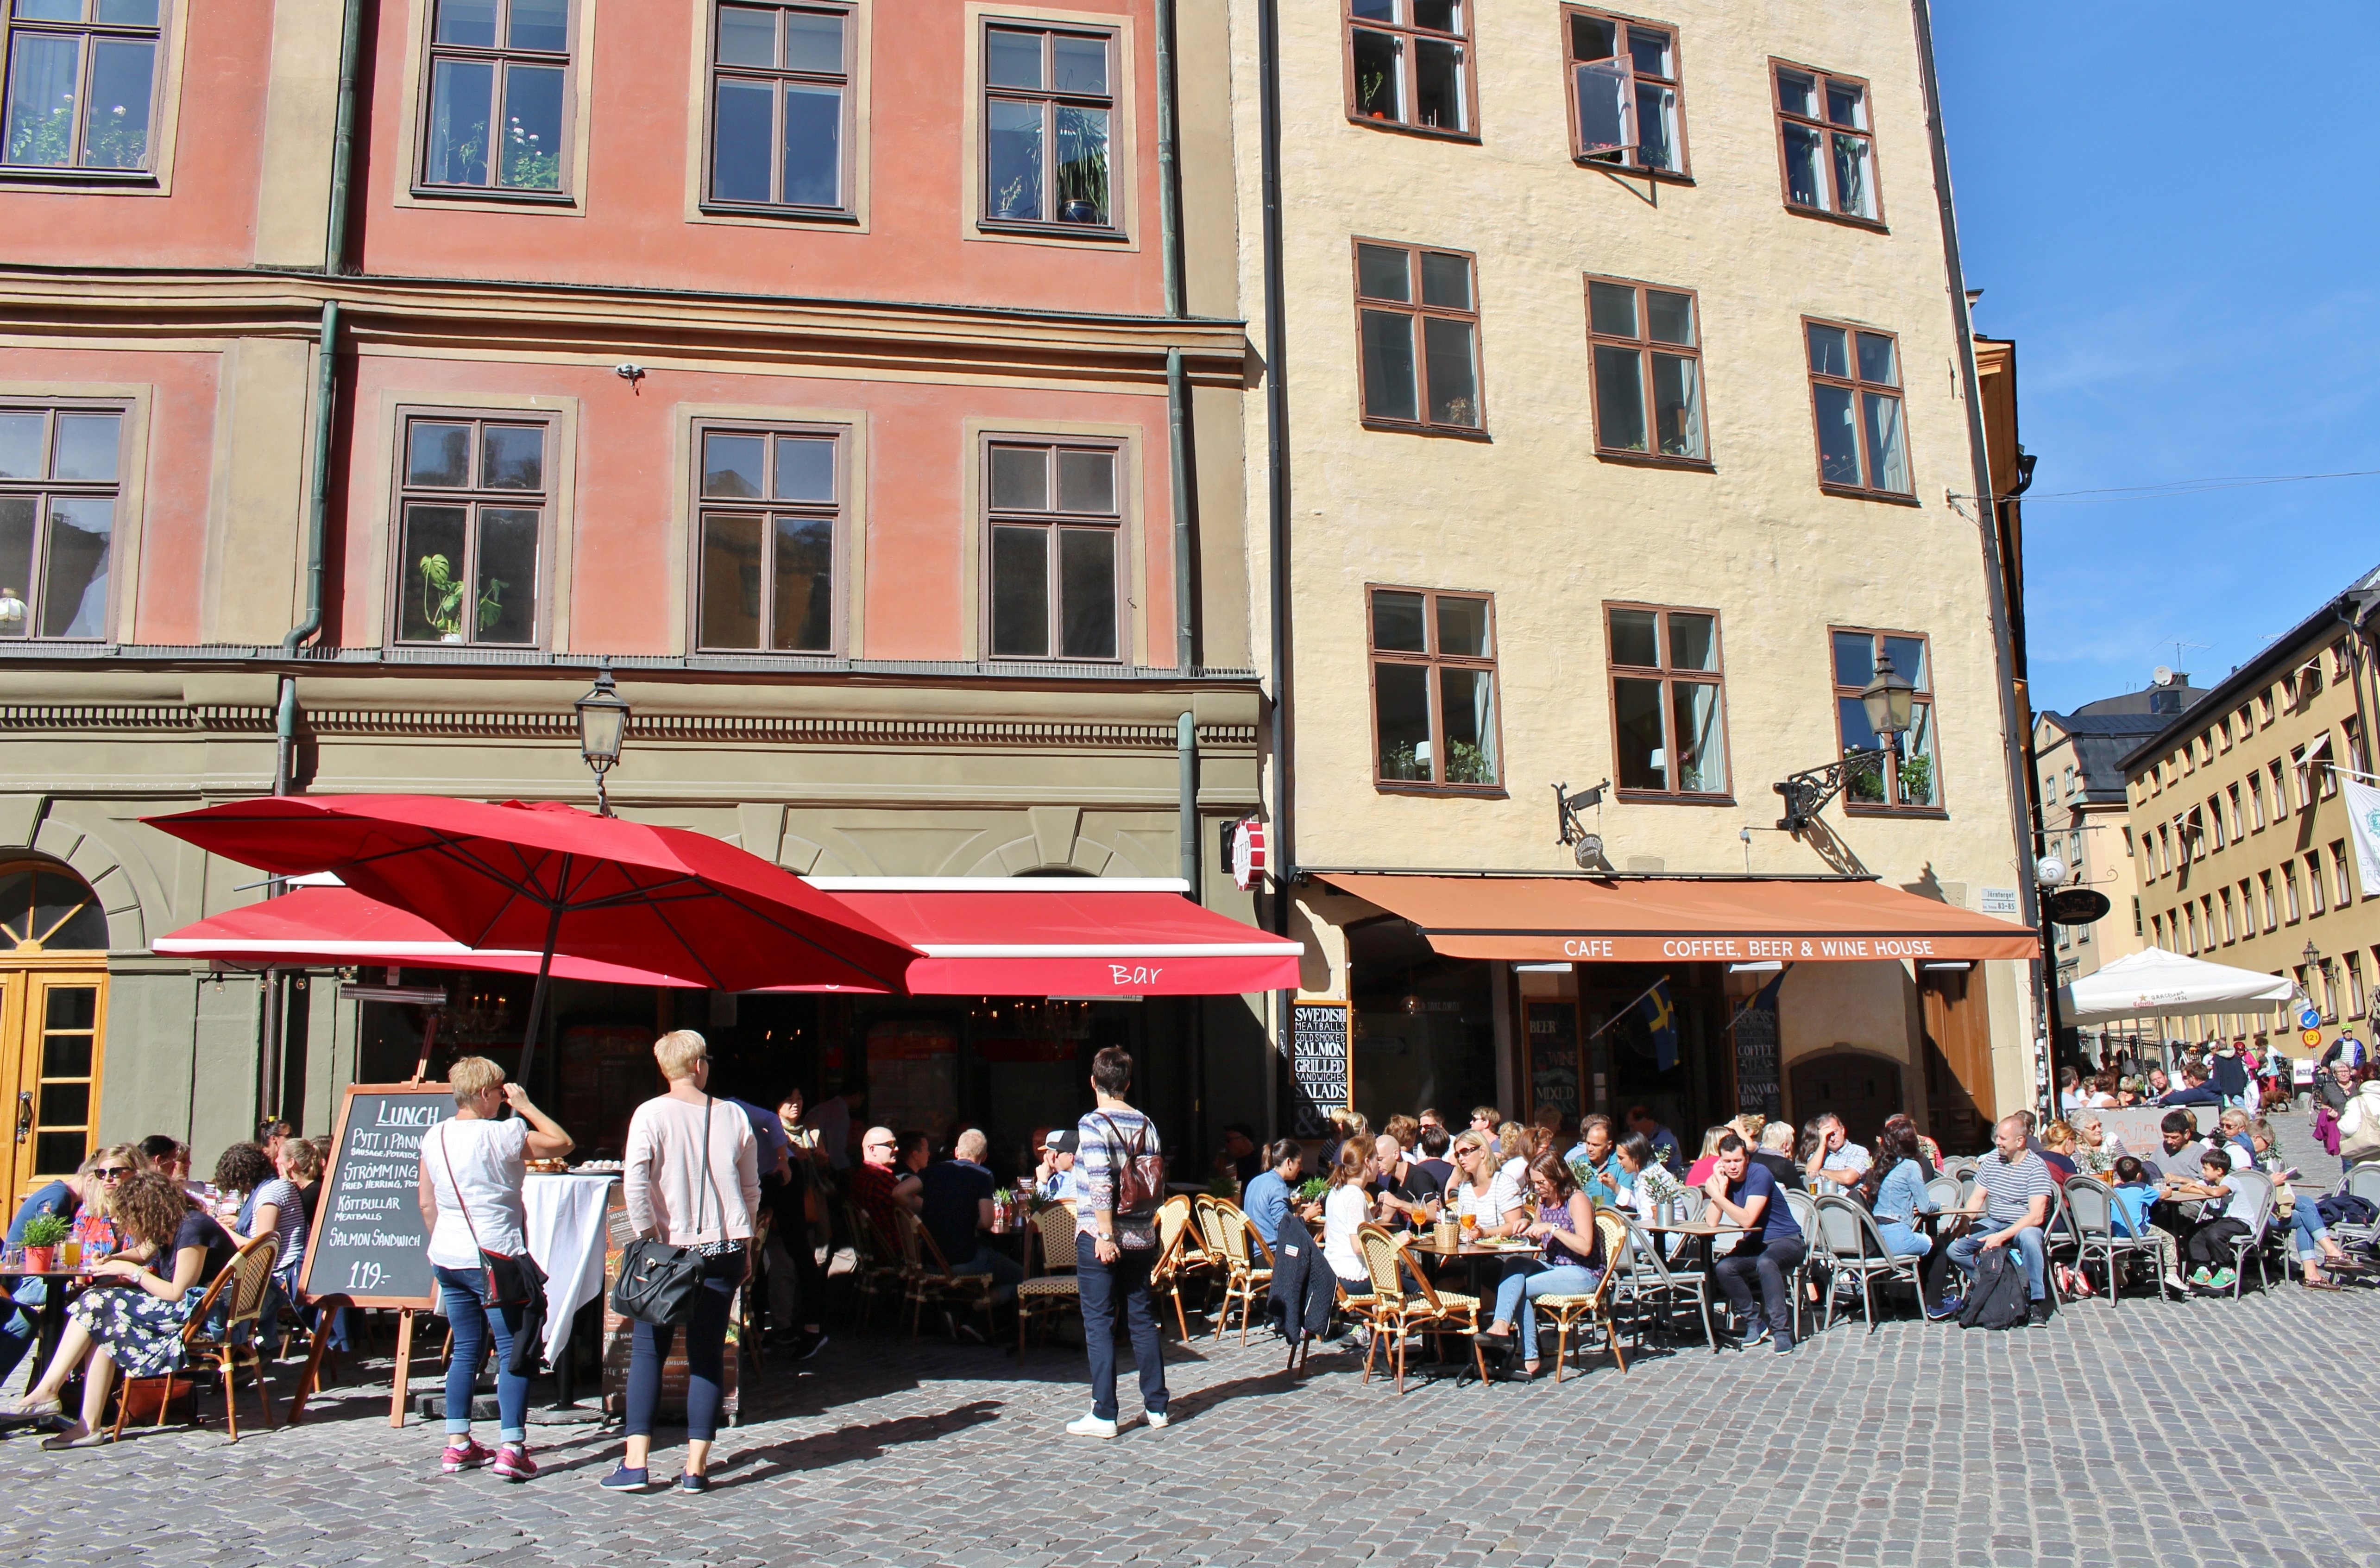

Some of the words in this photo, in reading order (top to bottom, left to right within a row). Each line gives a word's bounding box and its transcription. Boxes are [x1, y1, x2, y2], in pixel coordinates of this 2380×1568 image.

[1235, 840, 1249, 866] JTP
[1987, 891, 2014, 899] Järntorget
[1564, 940, 1613, 957] CAFE
[1663, 940, 1741, 958] COFFEE,
[1749, 941, 1793, 956] BEER
[1801, 941, 1813, 956] &
[1820, 941, 1868, 956] WINE
[1875, 940, 1934, 955] HOUSE
[1108, 964, 1163, 985] Bar
[2151, 991, 2184, 1000] BARCELONA
[1295, 1008, 1347, 1022] SWEDISH
[1295, 1022, 1345, 1031] MEATBALLS
[1529, 1020, 1556, 1033] BEER
[1295, 1033, 1314, 1042] COLD
[1316, 1033, 1345, 1043] SMOKED
[1295, 1042, 1345, 1056] SALMON
[1738, 1045, 1774, 1056] COFFEE
[1547, 1051, 1576, 1066] WINE
[1295, 1059, 1345, 1073] GRILLED
[1296, 1073, 1346, 1081] SANDWICHES
[1296, 1083, 1347, 1099] SALADS
[1536, 1087, 1574, 1100] MIXED
[1738, 1083, 1780, 1094] CINNAMON
[1741, 1094, 1763, 1106] BUNS
[377, 1100, 439, 1125] LUNCH
[1316, 1104, 1347, 1118] MO
[352, 1127, 382, 1149] PYTT
[390, 1132, 422, 1150] PANN
[344, 1162, 418, 1181] STRÖMMING
[341, 1181, 363, 1191] FRIED
[365, 1179, 403, 1189] HERRING,
[337, 1195, 401, 1212] KÖTTBULLAR
[334, 1212, 382, 1222] MEATBALLS
[329, 1227, 371, 1246] SALMON
[371, 1229, 421, 1247] SANDWICH
